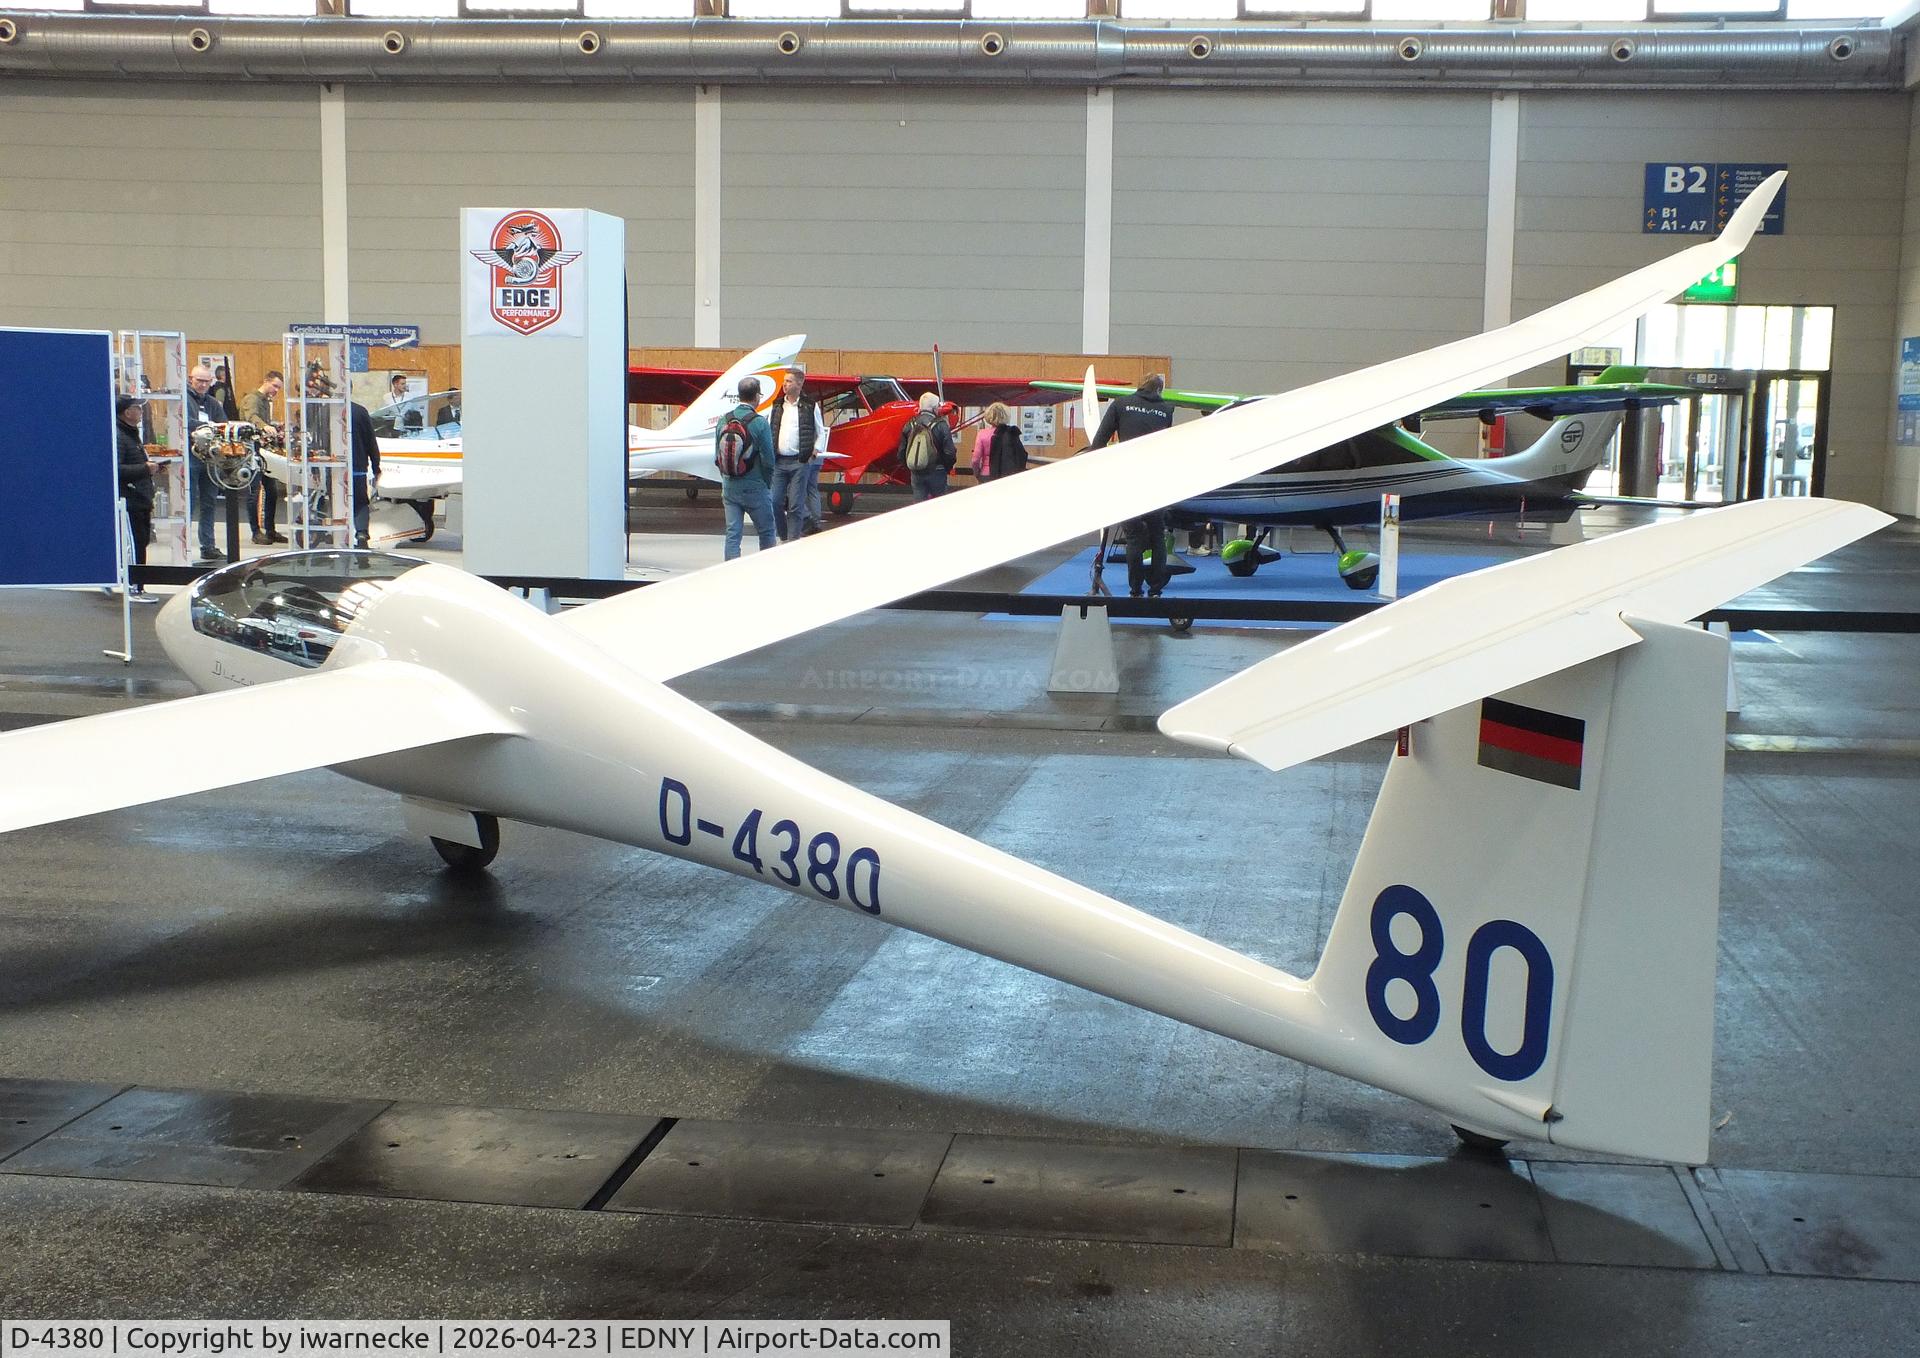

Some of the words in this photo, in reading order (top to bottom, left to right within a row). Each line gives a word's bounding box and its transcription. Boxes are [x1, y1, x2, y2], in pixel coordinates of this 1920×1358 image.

[1664, 166, 1708, 193] B2
[1662, 207, 1677, 218] B1
[1661, 220, 1677, 230] A1
[1690, 221, 1706, 231] A7
[502, 289, 550, 307] EDGE
[501, 309, 551, 317] PERFORMANCE
[293, 325, 329, 335] Gesellschaft
[343, 326, 378, 336] Bewahrung
[659, 776, 881, 915] D-4380
[1365, 884, 1554, 1081] 80
